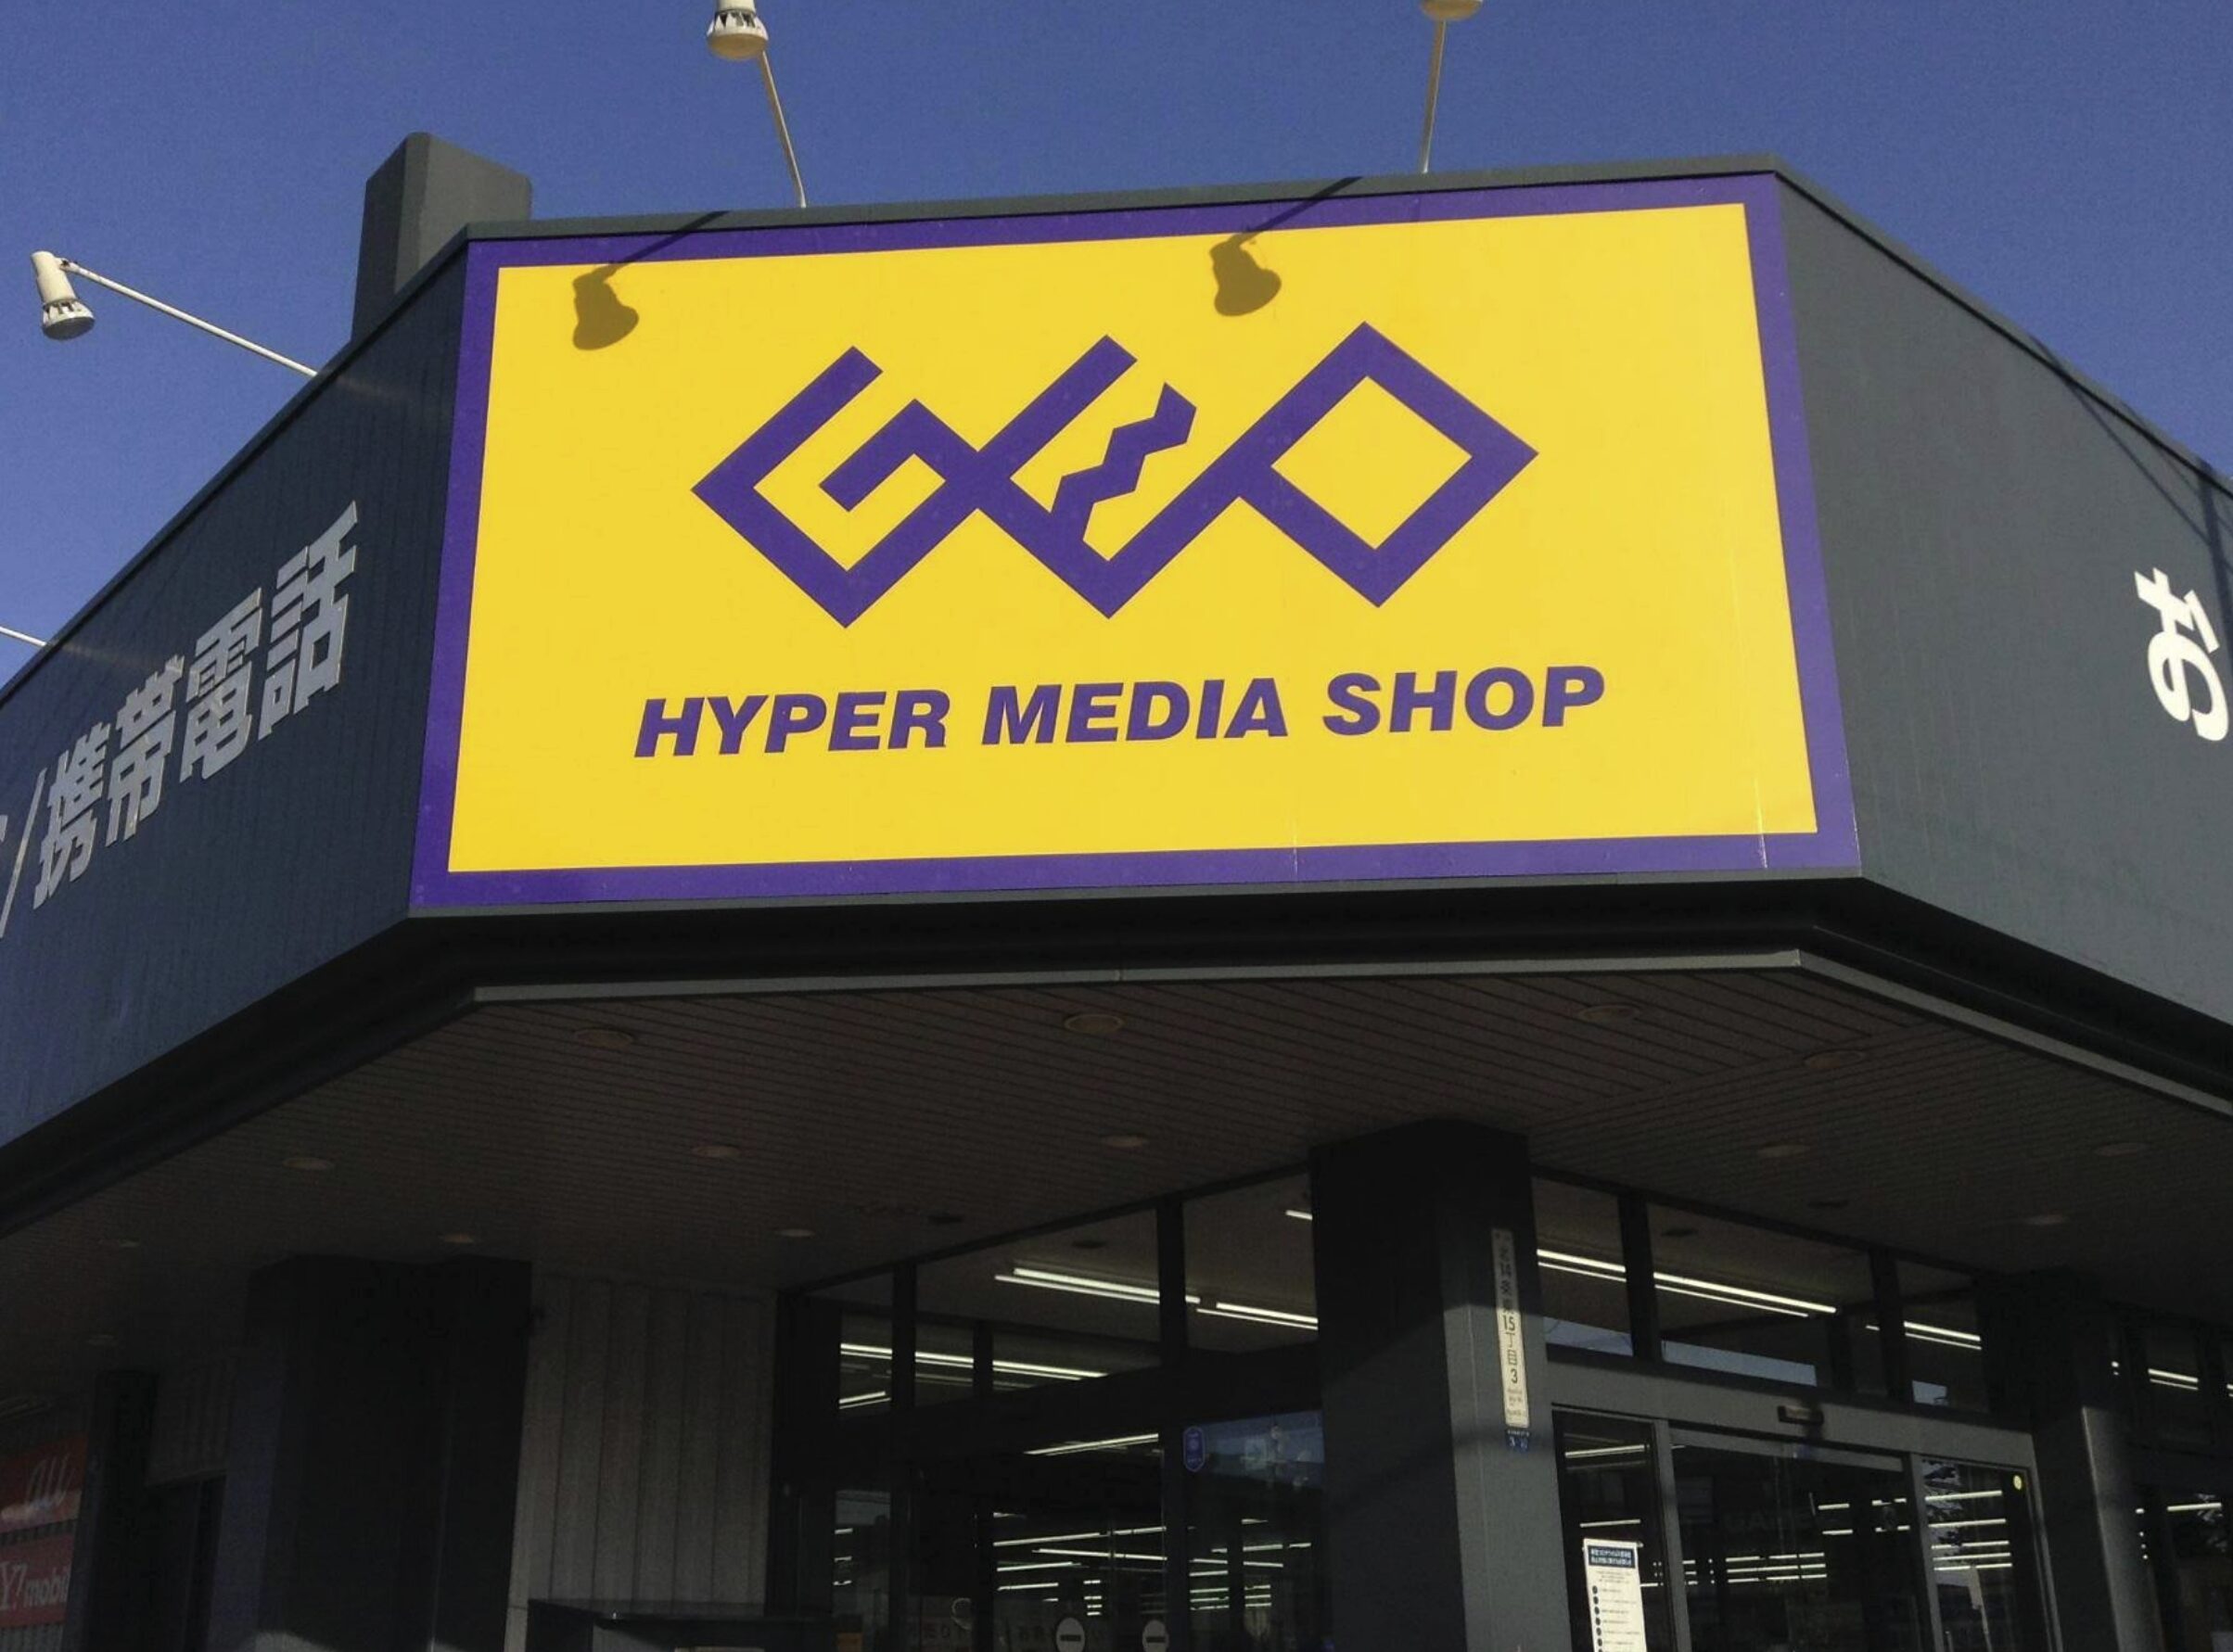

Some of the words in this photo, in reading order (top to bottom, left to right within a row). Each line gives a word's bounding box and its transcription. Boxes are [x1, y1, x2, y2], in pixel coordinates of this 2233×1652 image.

[633, 689, 951, 758] HYPER
[980, 677, 1289, 745] MEDIA
[1321, 664, 1605, 736] SHOP
[2134, 566, 2229, 742] お
